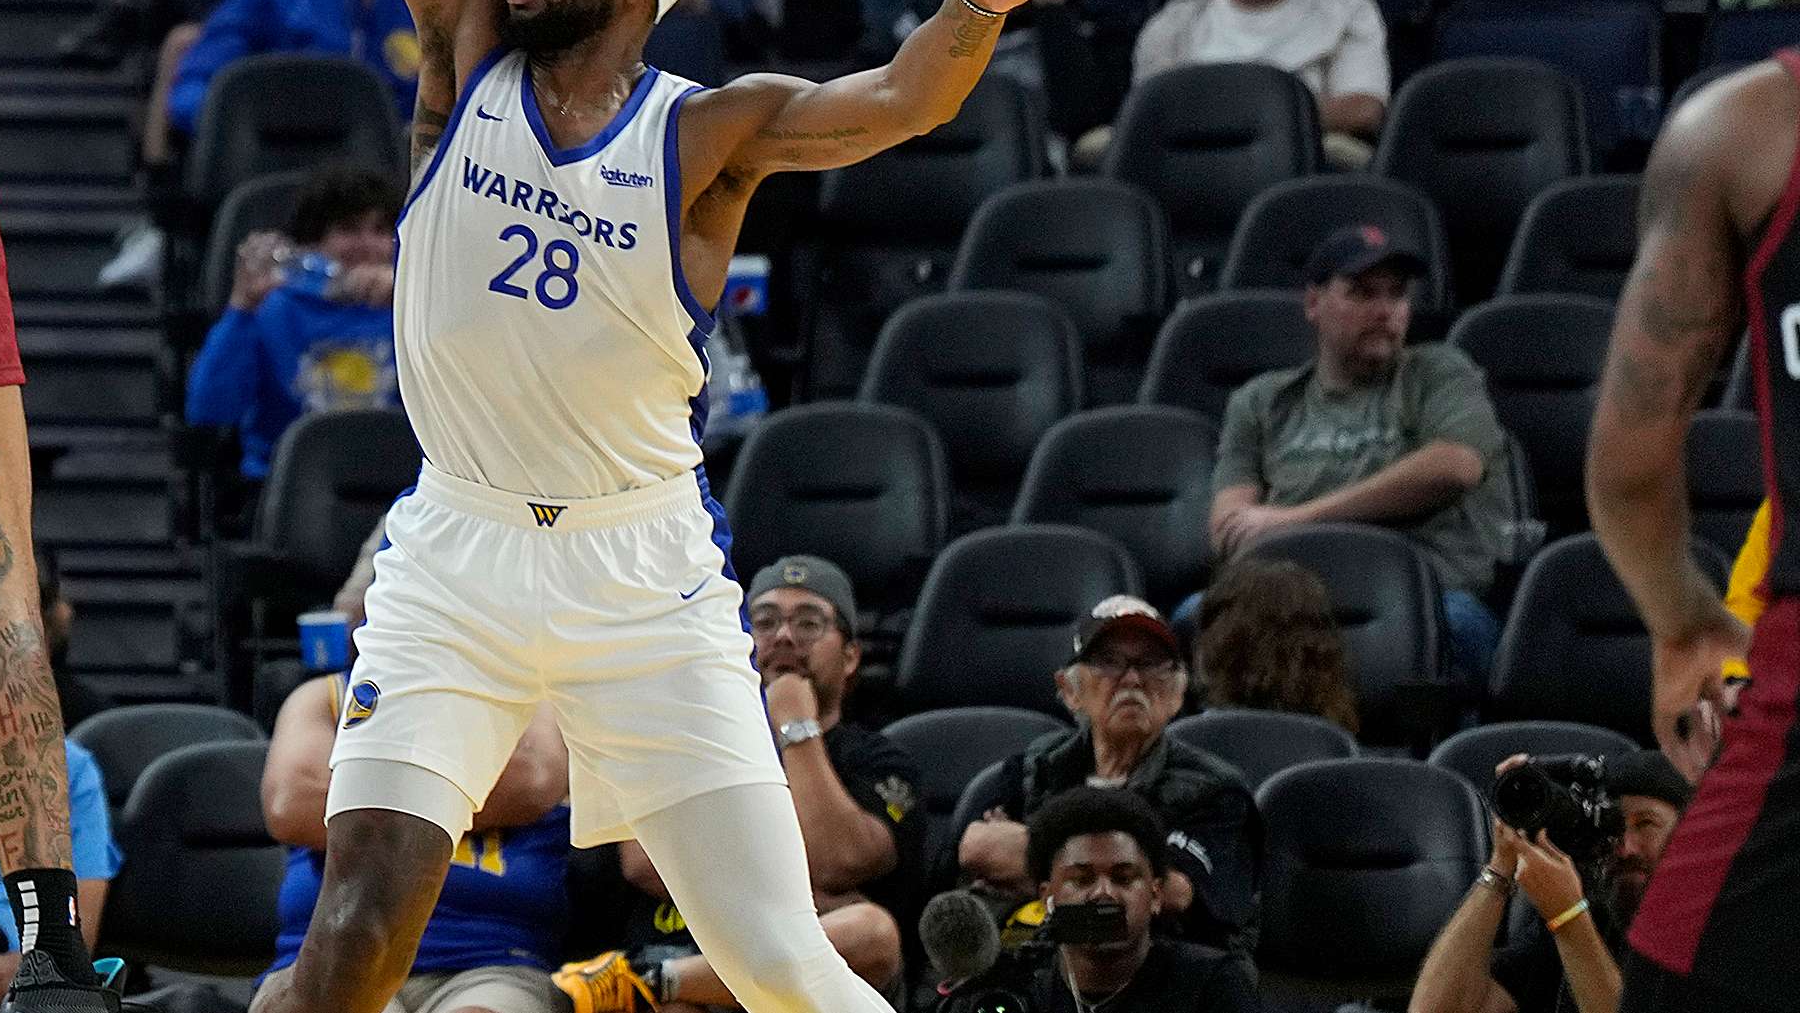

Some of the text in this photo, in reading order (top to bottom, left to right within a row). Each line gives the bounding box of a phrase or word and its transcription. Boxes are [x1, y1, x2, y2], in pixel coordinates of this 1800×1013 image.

[463, 157, 638, 250] WARRIORS
[600, 165, 653, 188] Rakuten
[488, 223, 580, 311] 28
